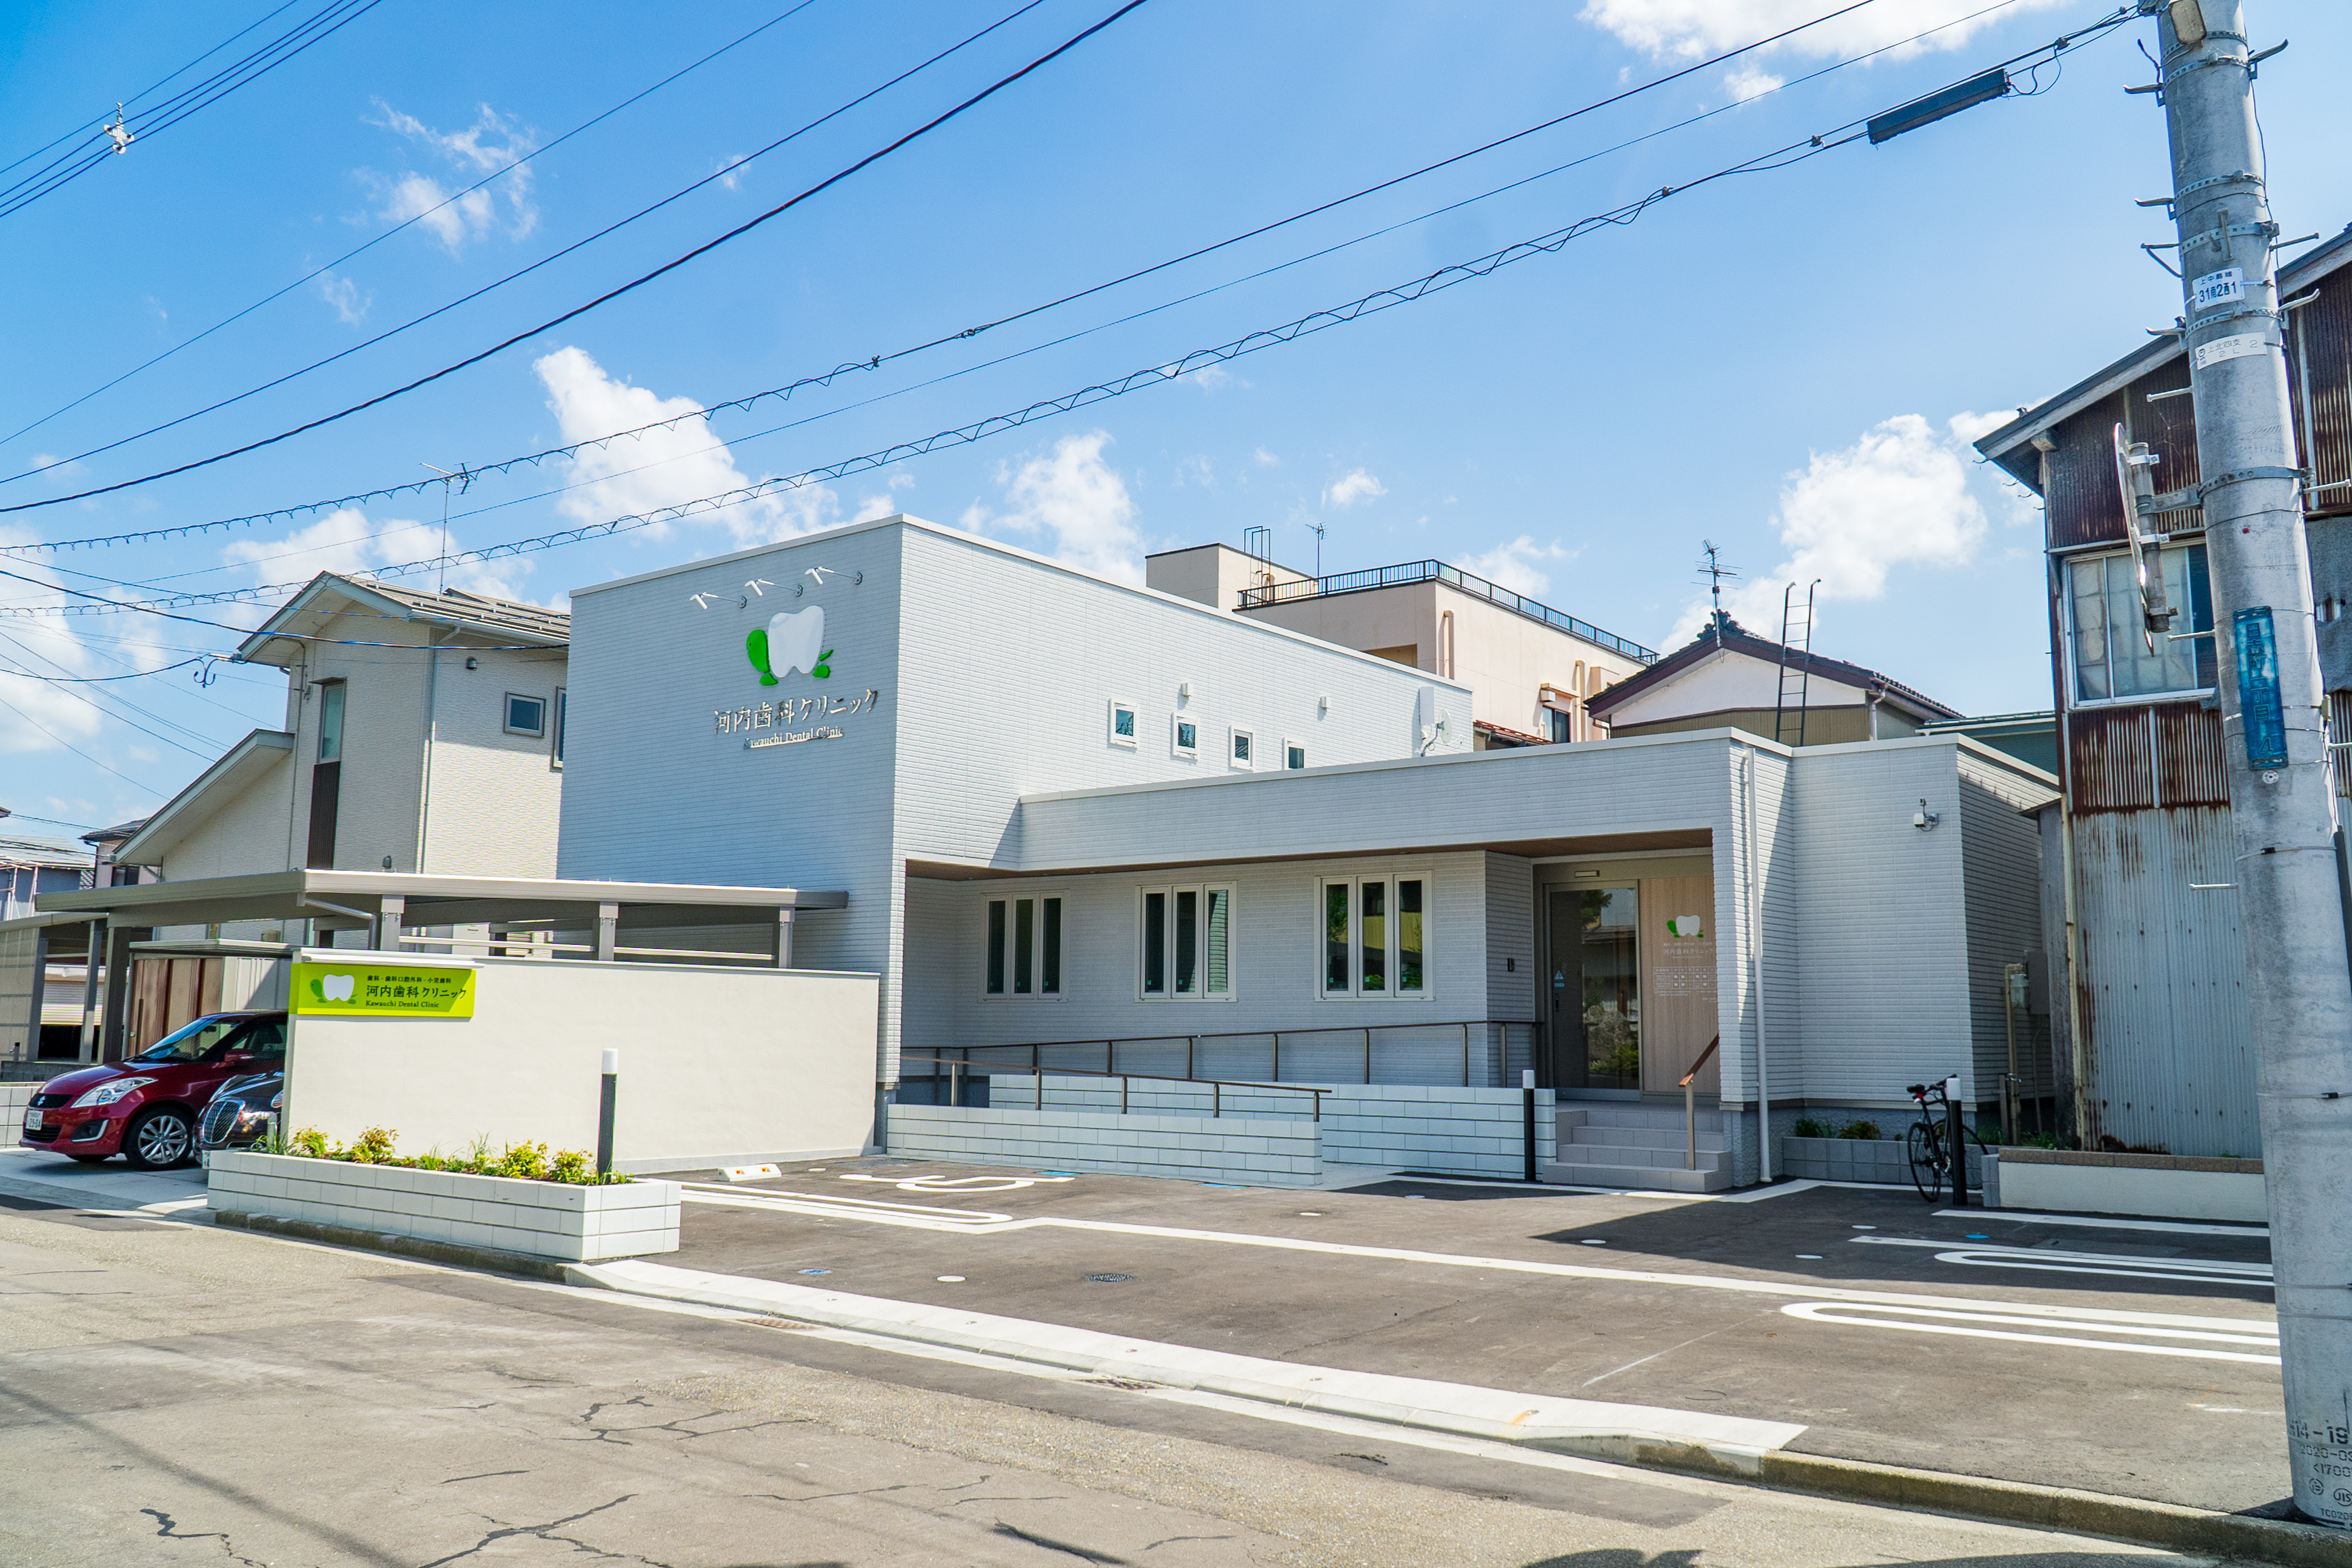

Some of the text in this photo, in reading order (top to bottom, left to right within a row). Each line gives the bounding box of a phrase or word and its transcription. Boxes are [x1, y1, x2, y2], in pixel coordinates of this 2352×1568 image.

[2250, 339, 2258, 349] 2
[713, 689, 878, 735] 河内歯科クリニック
[743, 725, 844, 749] Kawauchi Dental Clinic
[366, 985, 467, 999] 河内歯科クリニック
[2334, 1492, 2351, 1503] JIS
